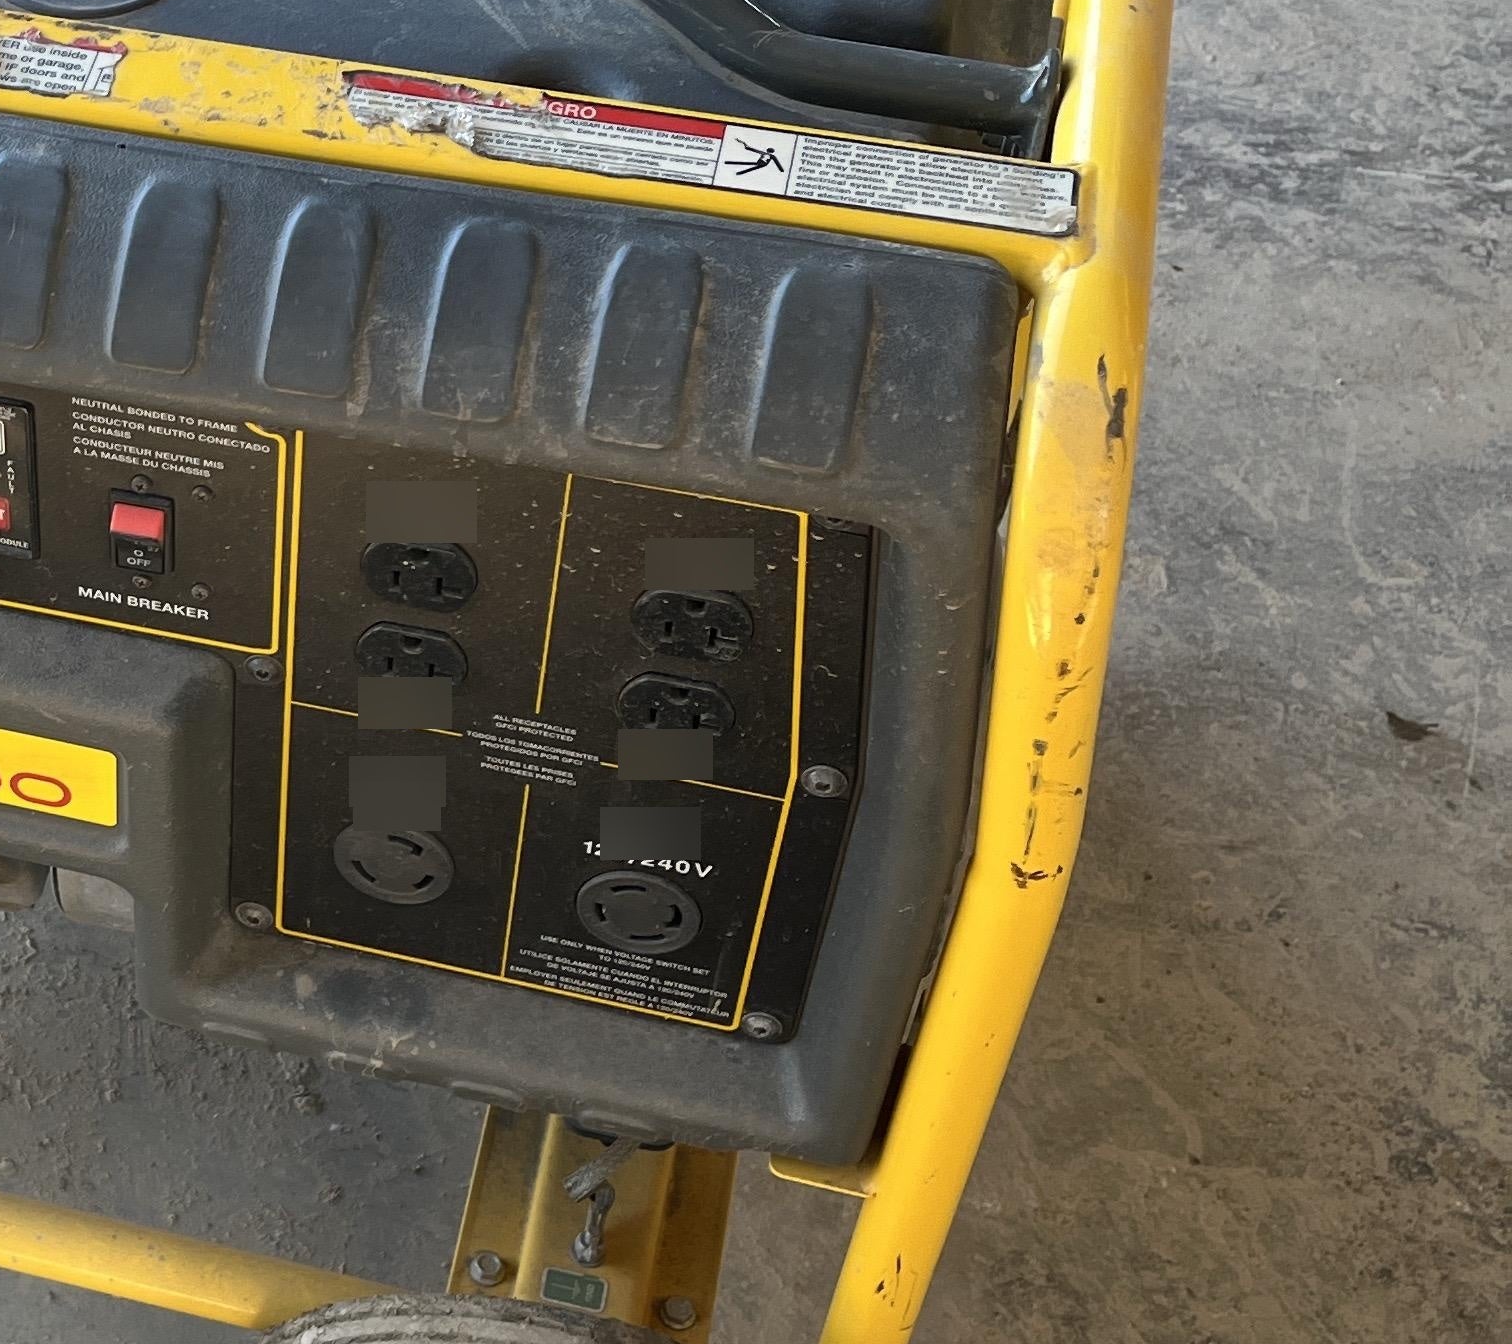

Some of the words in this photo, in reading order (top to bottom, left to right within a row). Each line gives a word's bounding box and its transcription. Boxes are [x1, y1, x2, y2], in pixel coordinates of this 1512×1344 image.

[50, 49, 88, 60] inside
[21, 66, 56, 77] doors
[38, 58, 84, 72] garage,
[21, 78, 40, 86] are
[45, 82, 76, 92] open
[72, 396, 124, 413] NEUTRAL
[128, 406, 175, 422] BONDED
[179, 415, 194, 425] TO
[198, 419, 238, 433] FRAME
[72, 423, 88, 431] AL
[89, 425, 131, 439] CHASIS
[72, 412, 144, 430] CONDUCTOR
[148, 425, 195, 440] NEUTRO
[198, 433, 270, 453] CONECTADO
[73, 436, 151, 456] CONDUCTEUR
[154, 450, 201, 465] NEUTRE
[203, 459, 224, 470] MIS
[84, 449, 98, 457] LA
[100, 451, 139, 465] MASSE
[142, 460, 159, 468] DU
[161, 462, 210, 478] CHASSIS
[126, 556, 151, 568] OFF
[78, 586, 122, 604] MAIN
[128, 597, 209, 620] BREAKER
[512, 717, 576, 735] RECEPTACLES
[519, 727, 573, 742] PROTECTED
[560, 939, 583, 949] ONLY
